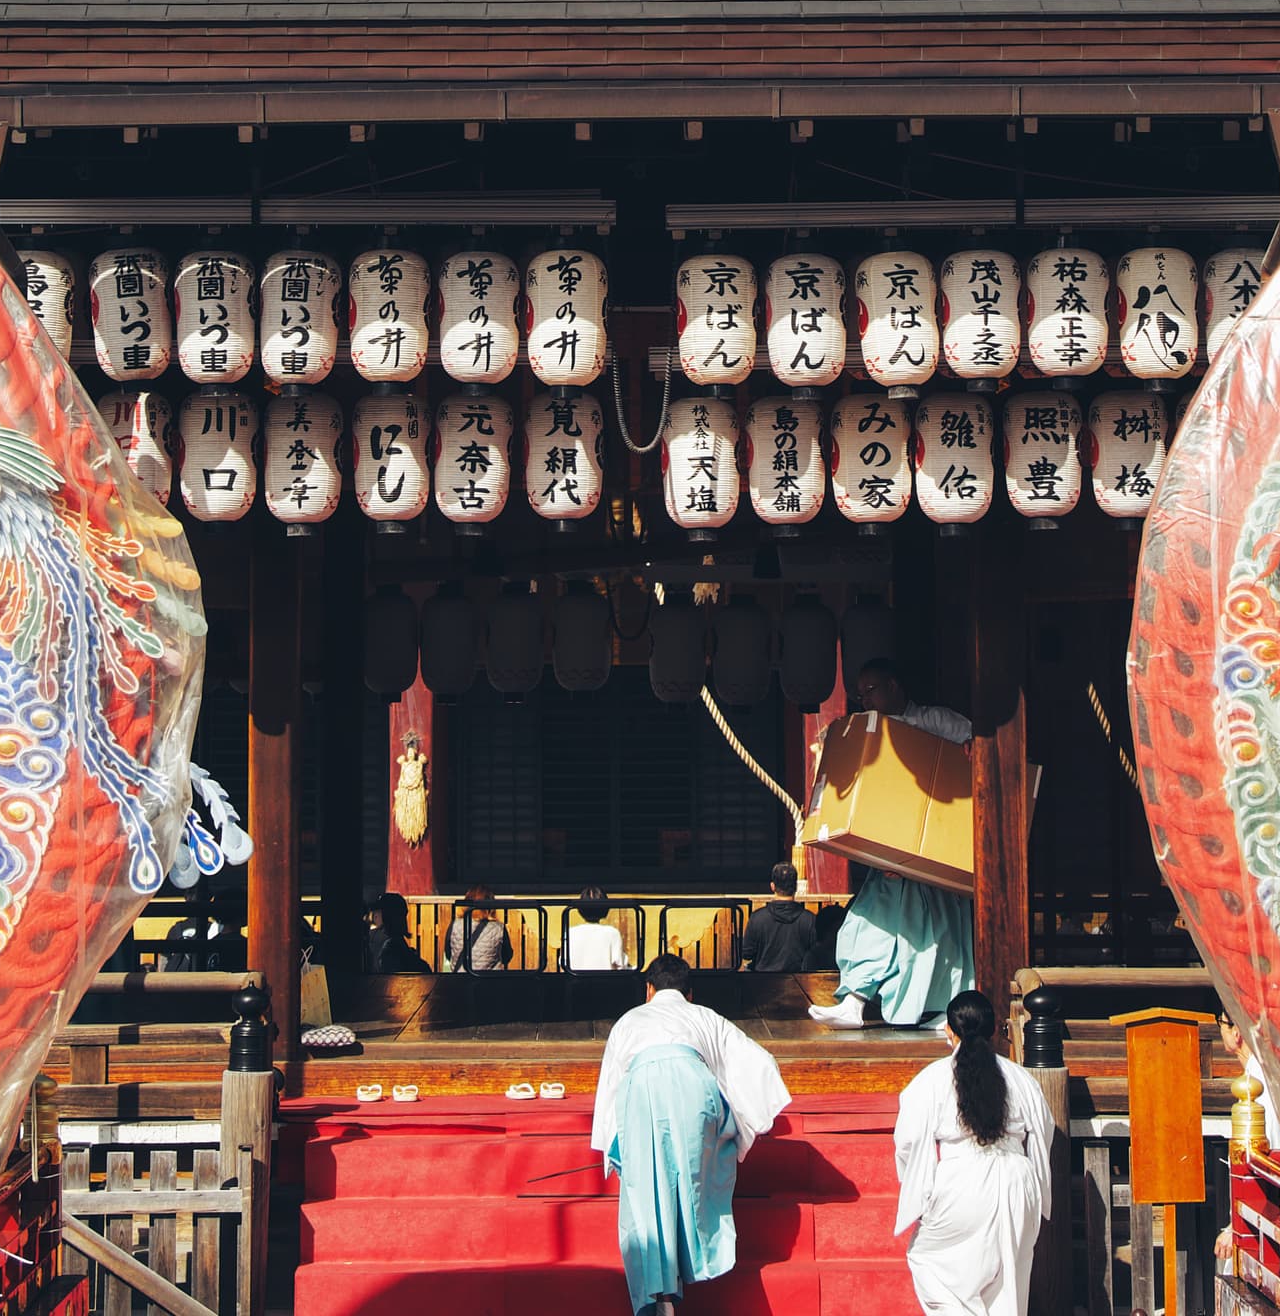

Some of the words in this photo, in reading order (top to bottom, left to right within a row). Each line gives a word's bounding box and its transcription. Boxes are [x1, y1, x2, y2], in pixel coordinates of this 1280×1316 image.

[702, 262, 742, 368] 京ばん
[785, 262, 826, 370] 京ばん
[883, 263, 925, 366] 京ばん
[968, 259, 1003, 366] 茂山千之丞
[201, 406, 238, 491] 川口
[370, 424, 405, 503] にし
[453, 404, 495, 509] 元奈古
[858, 402, 896, 509] みの家
[1022, 407, 1063, 501] 照豊
